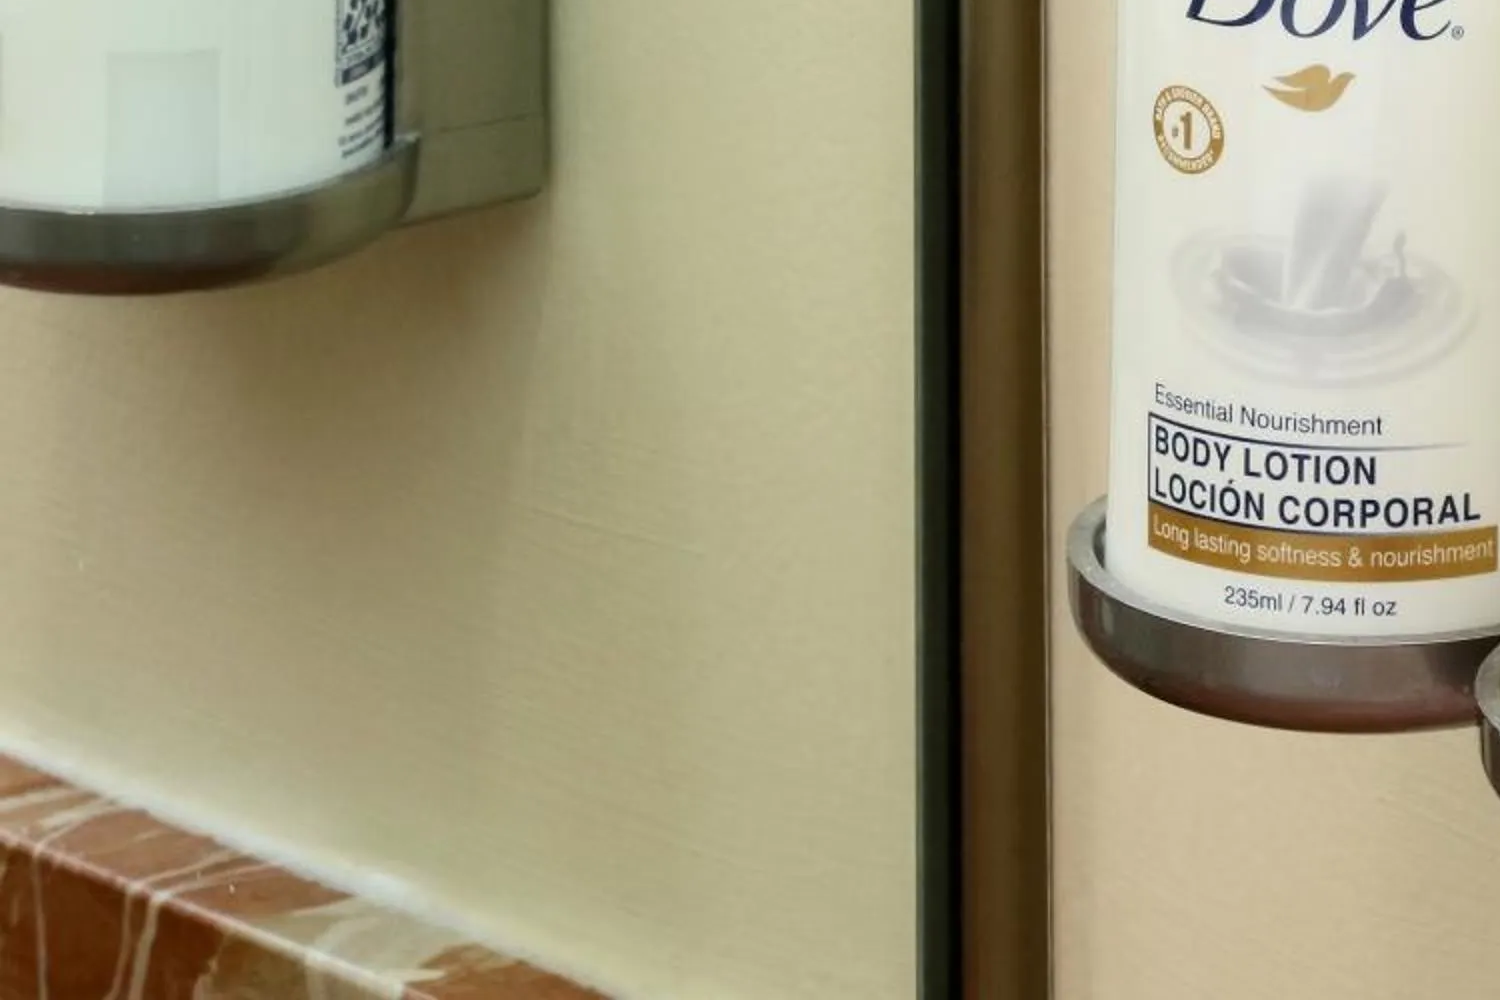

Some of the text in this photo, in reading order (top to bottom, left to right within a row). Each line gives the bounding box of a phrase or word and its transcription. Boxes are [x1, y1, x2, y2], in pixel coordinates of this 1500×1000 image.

[1155, 382, 1383, 436] Essential Nourishment
[1155, 425, 1377, 486] BODY LOTION
[1154, 467, 1482, 529] LOCIÓN CORPORAL
[1153, 513, 1495, 569] Long lasting softness & nourishment
[1223, 585, 1284, 611] 235ml
[1300, 596, 1347, 617] 7.94
[1373, 600, 1398, 618] oz
